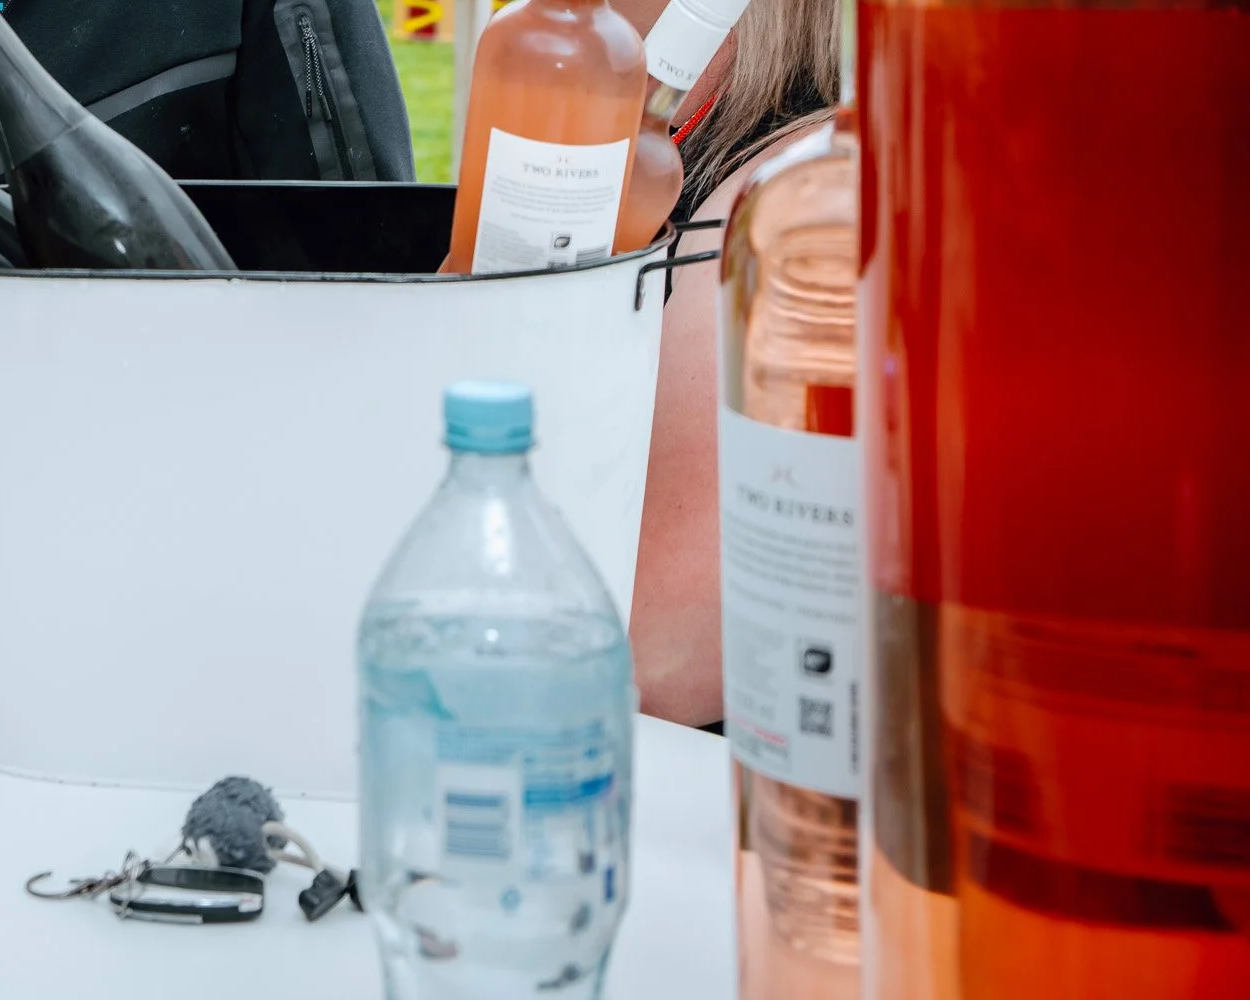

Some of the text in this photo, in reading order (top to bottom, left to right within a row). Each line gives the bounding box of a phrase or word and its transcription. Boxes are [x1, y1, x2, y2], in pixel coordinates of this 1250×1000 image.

[658, 56, 685, 79] TWO
[523, 162, 600, 179] TWO RIVERS
[736, 482, 855, 527] TWO RIVERS
